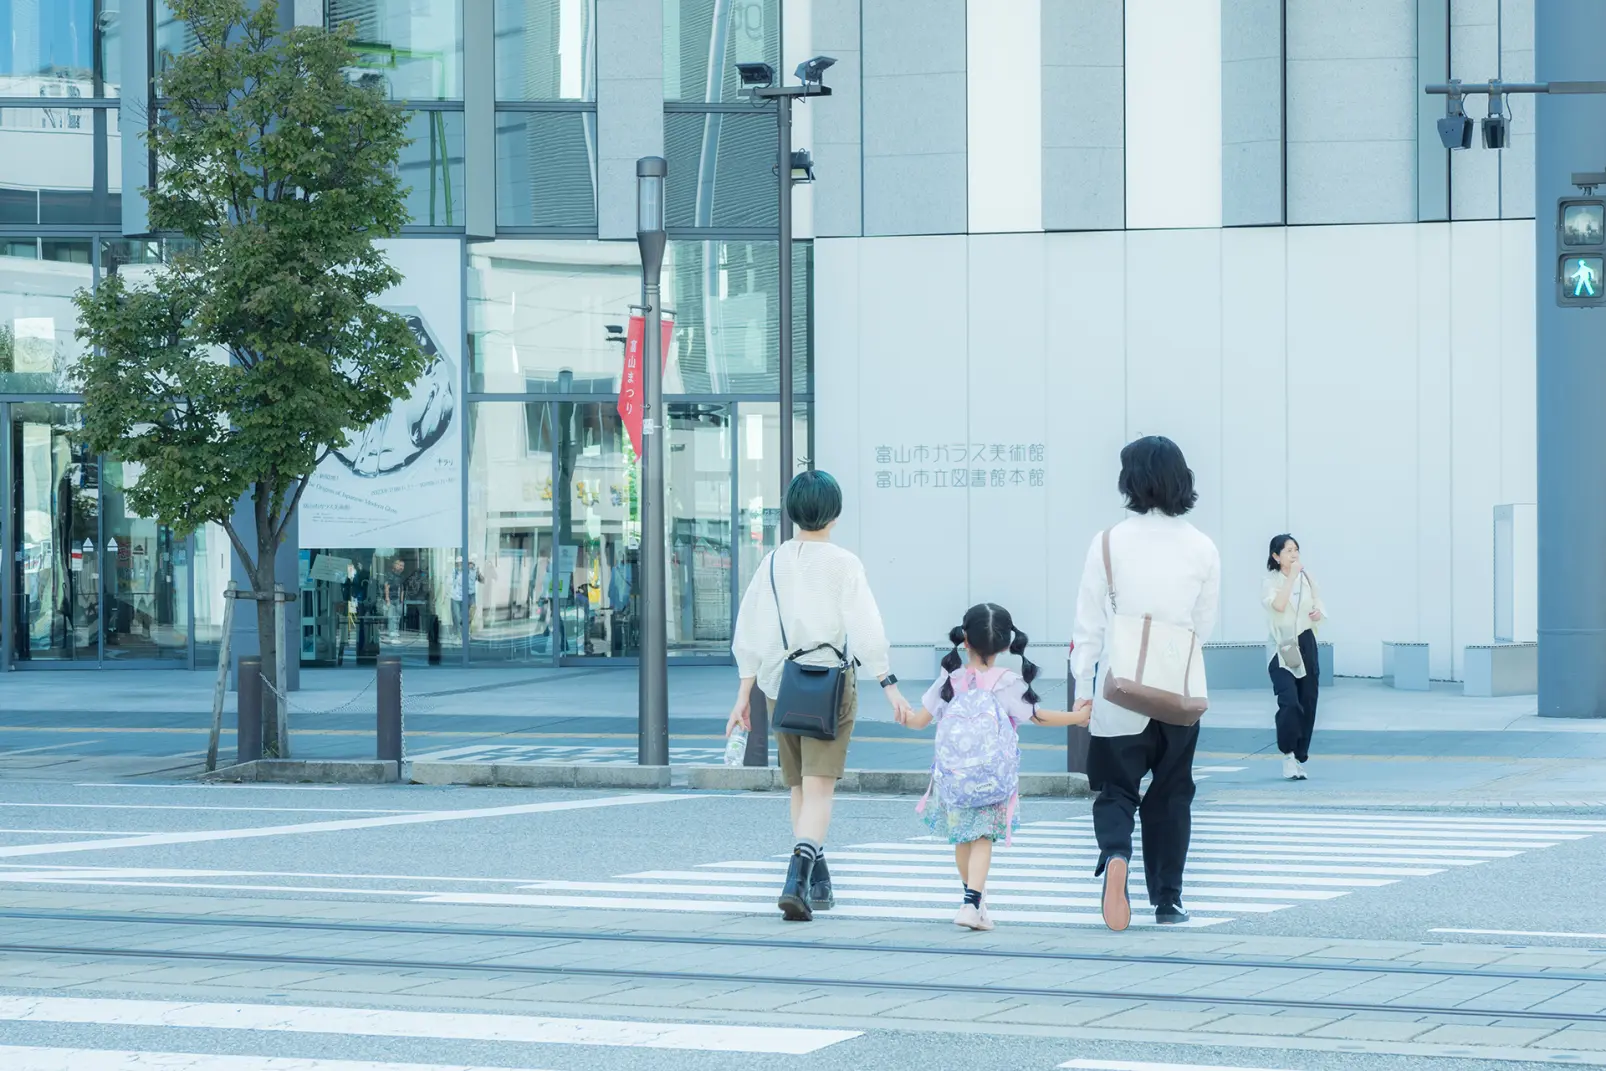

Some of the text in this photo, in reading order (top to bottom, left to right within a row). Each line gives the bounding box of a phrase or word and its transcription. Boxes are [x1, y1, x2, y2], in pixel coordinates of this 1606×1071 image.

[875, 443, 1045, 464] 富山市ガラス美術館
[875, 468, 1045, 489] 富山市立図書館本館
